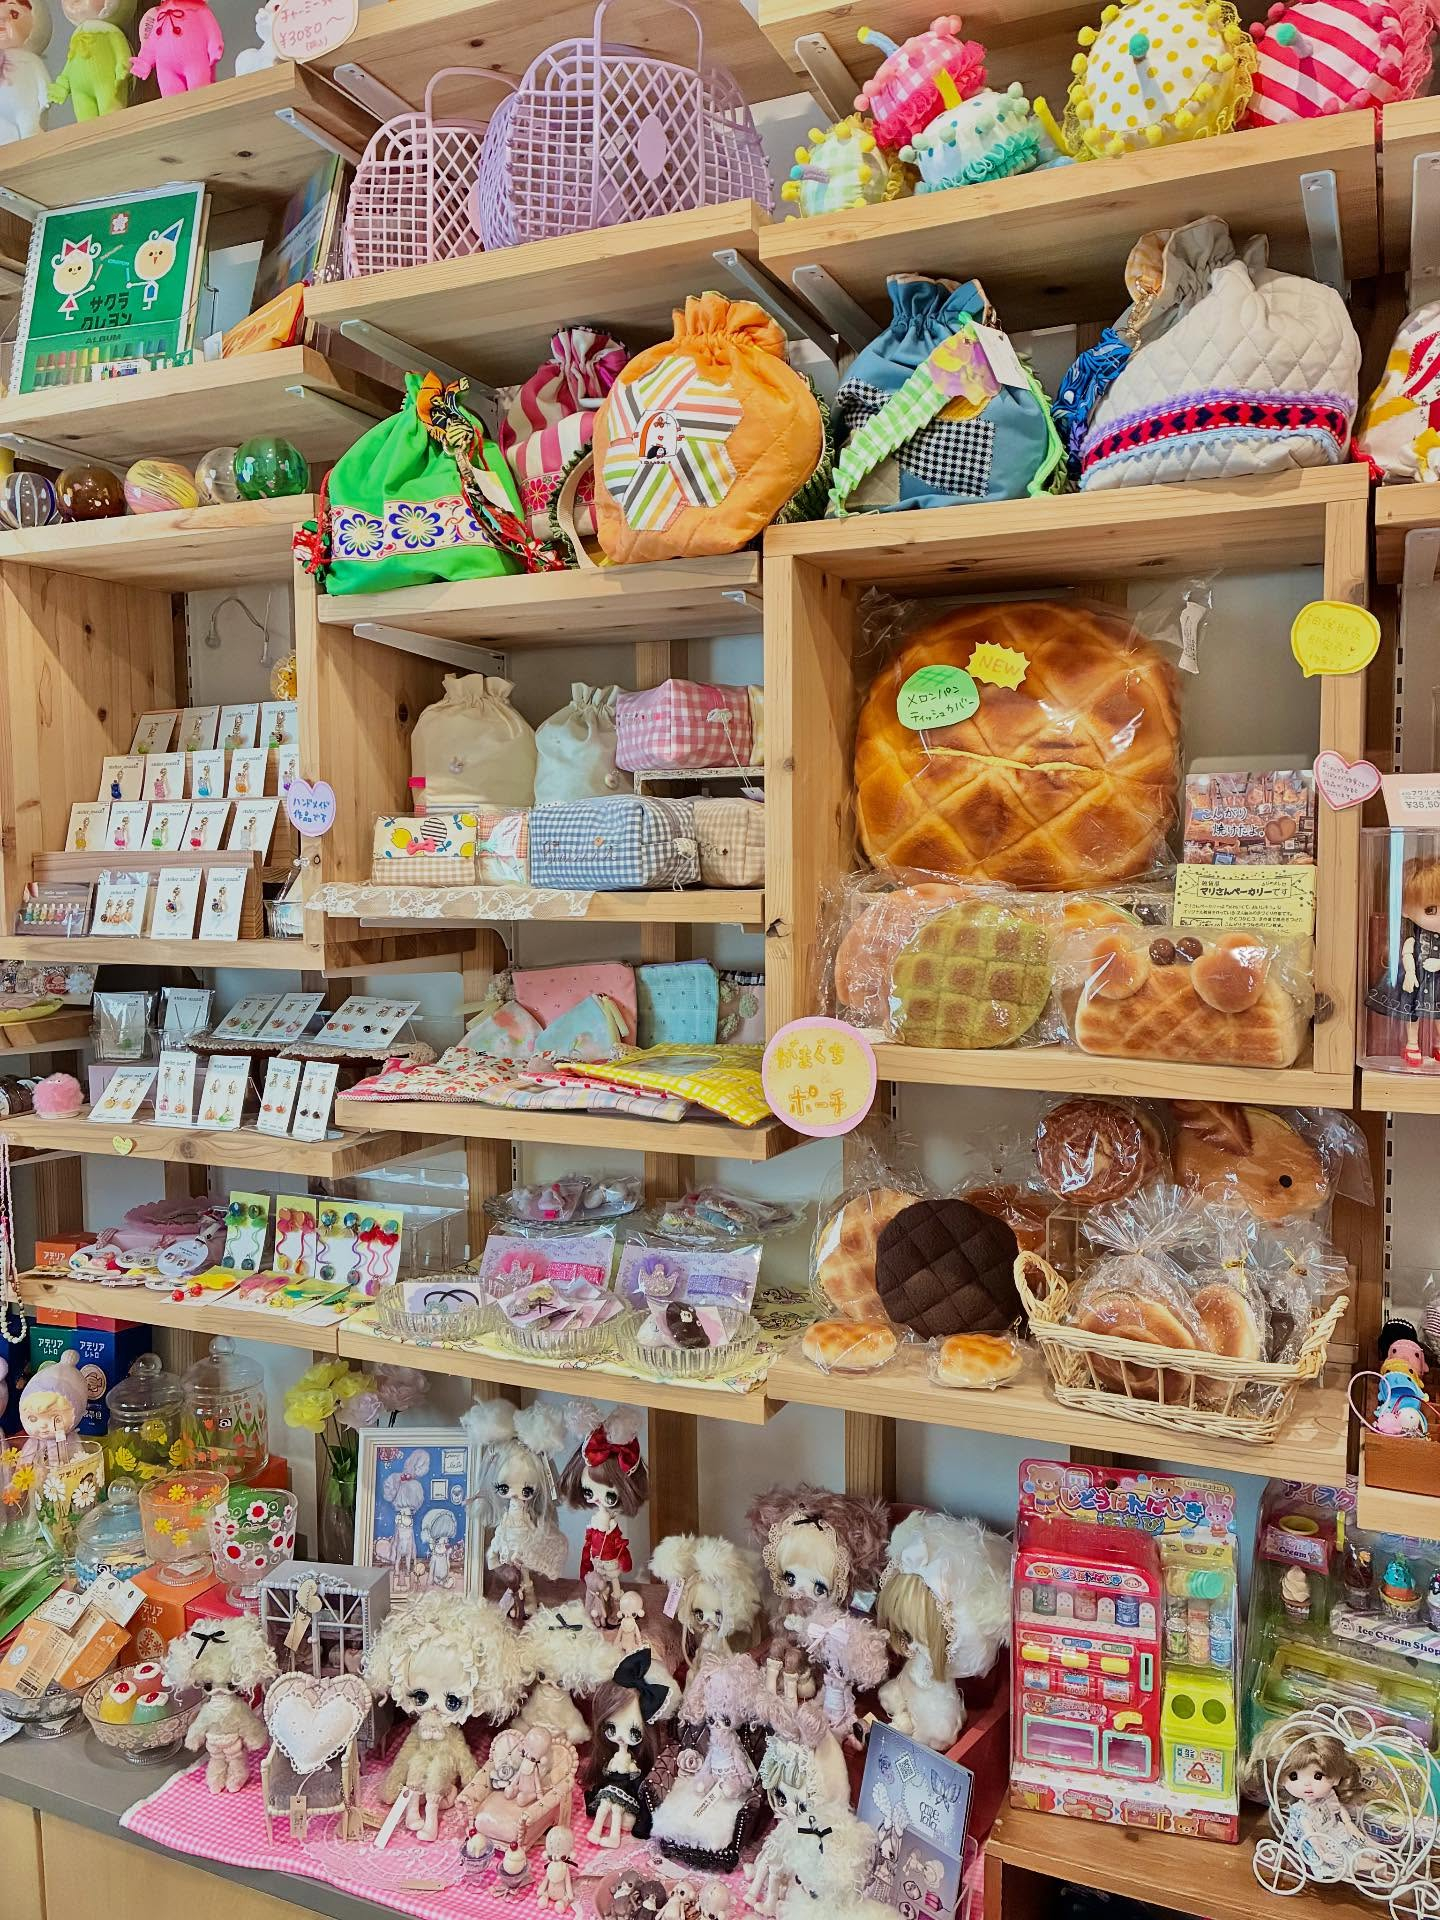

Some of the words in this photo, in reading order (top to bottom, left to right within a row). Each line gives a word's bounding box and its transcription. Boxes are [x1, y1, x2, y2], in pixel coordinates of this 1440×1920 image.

[89, 292, 130, 314] サクラ
[81, 312, 133, 331] クレヨン
[85, 333, 121, 344] ALBUM
[979, 655, 1021, 677] NEW
[908, 685, 960, 708] メロンパン
[293, 809, 327, 823] 作品です
[1201, 807, 1248, 820] こんがり
[1211, 822, 1265, 838] 焼けたよ。
[789, 1084, 847, 1117] ポーチ
[43, 1251, 66, 1261] アデリア
[38, 1338, 64, 1349] アデリア
[79, 1341, 105, 1352] アデリア
[84, 1350, 100, 1359] レトロ
[1060, 1486, 1205, 1523] じどうはんばいき
[1279, 1546, 1307, 1559] Cream
[143, 1602, 163, 1617] デリア
[1358, 1626, 1374, 1636] Ice
[1375, 1631, 1412, 1648] Cream
[1413, 1641, 1440, 1660] Shop
